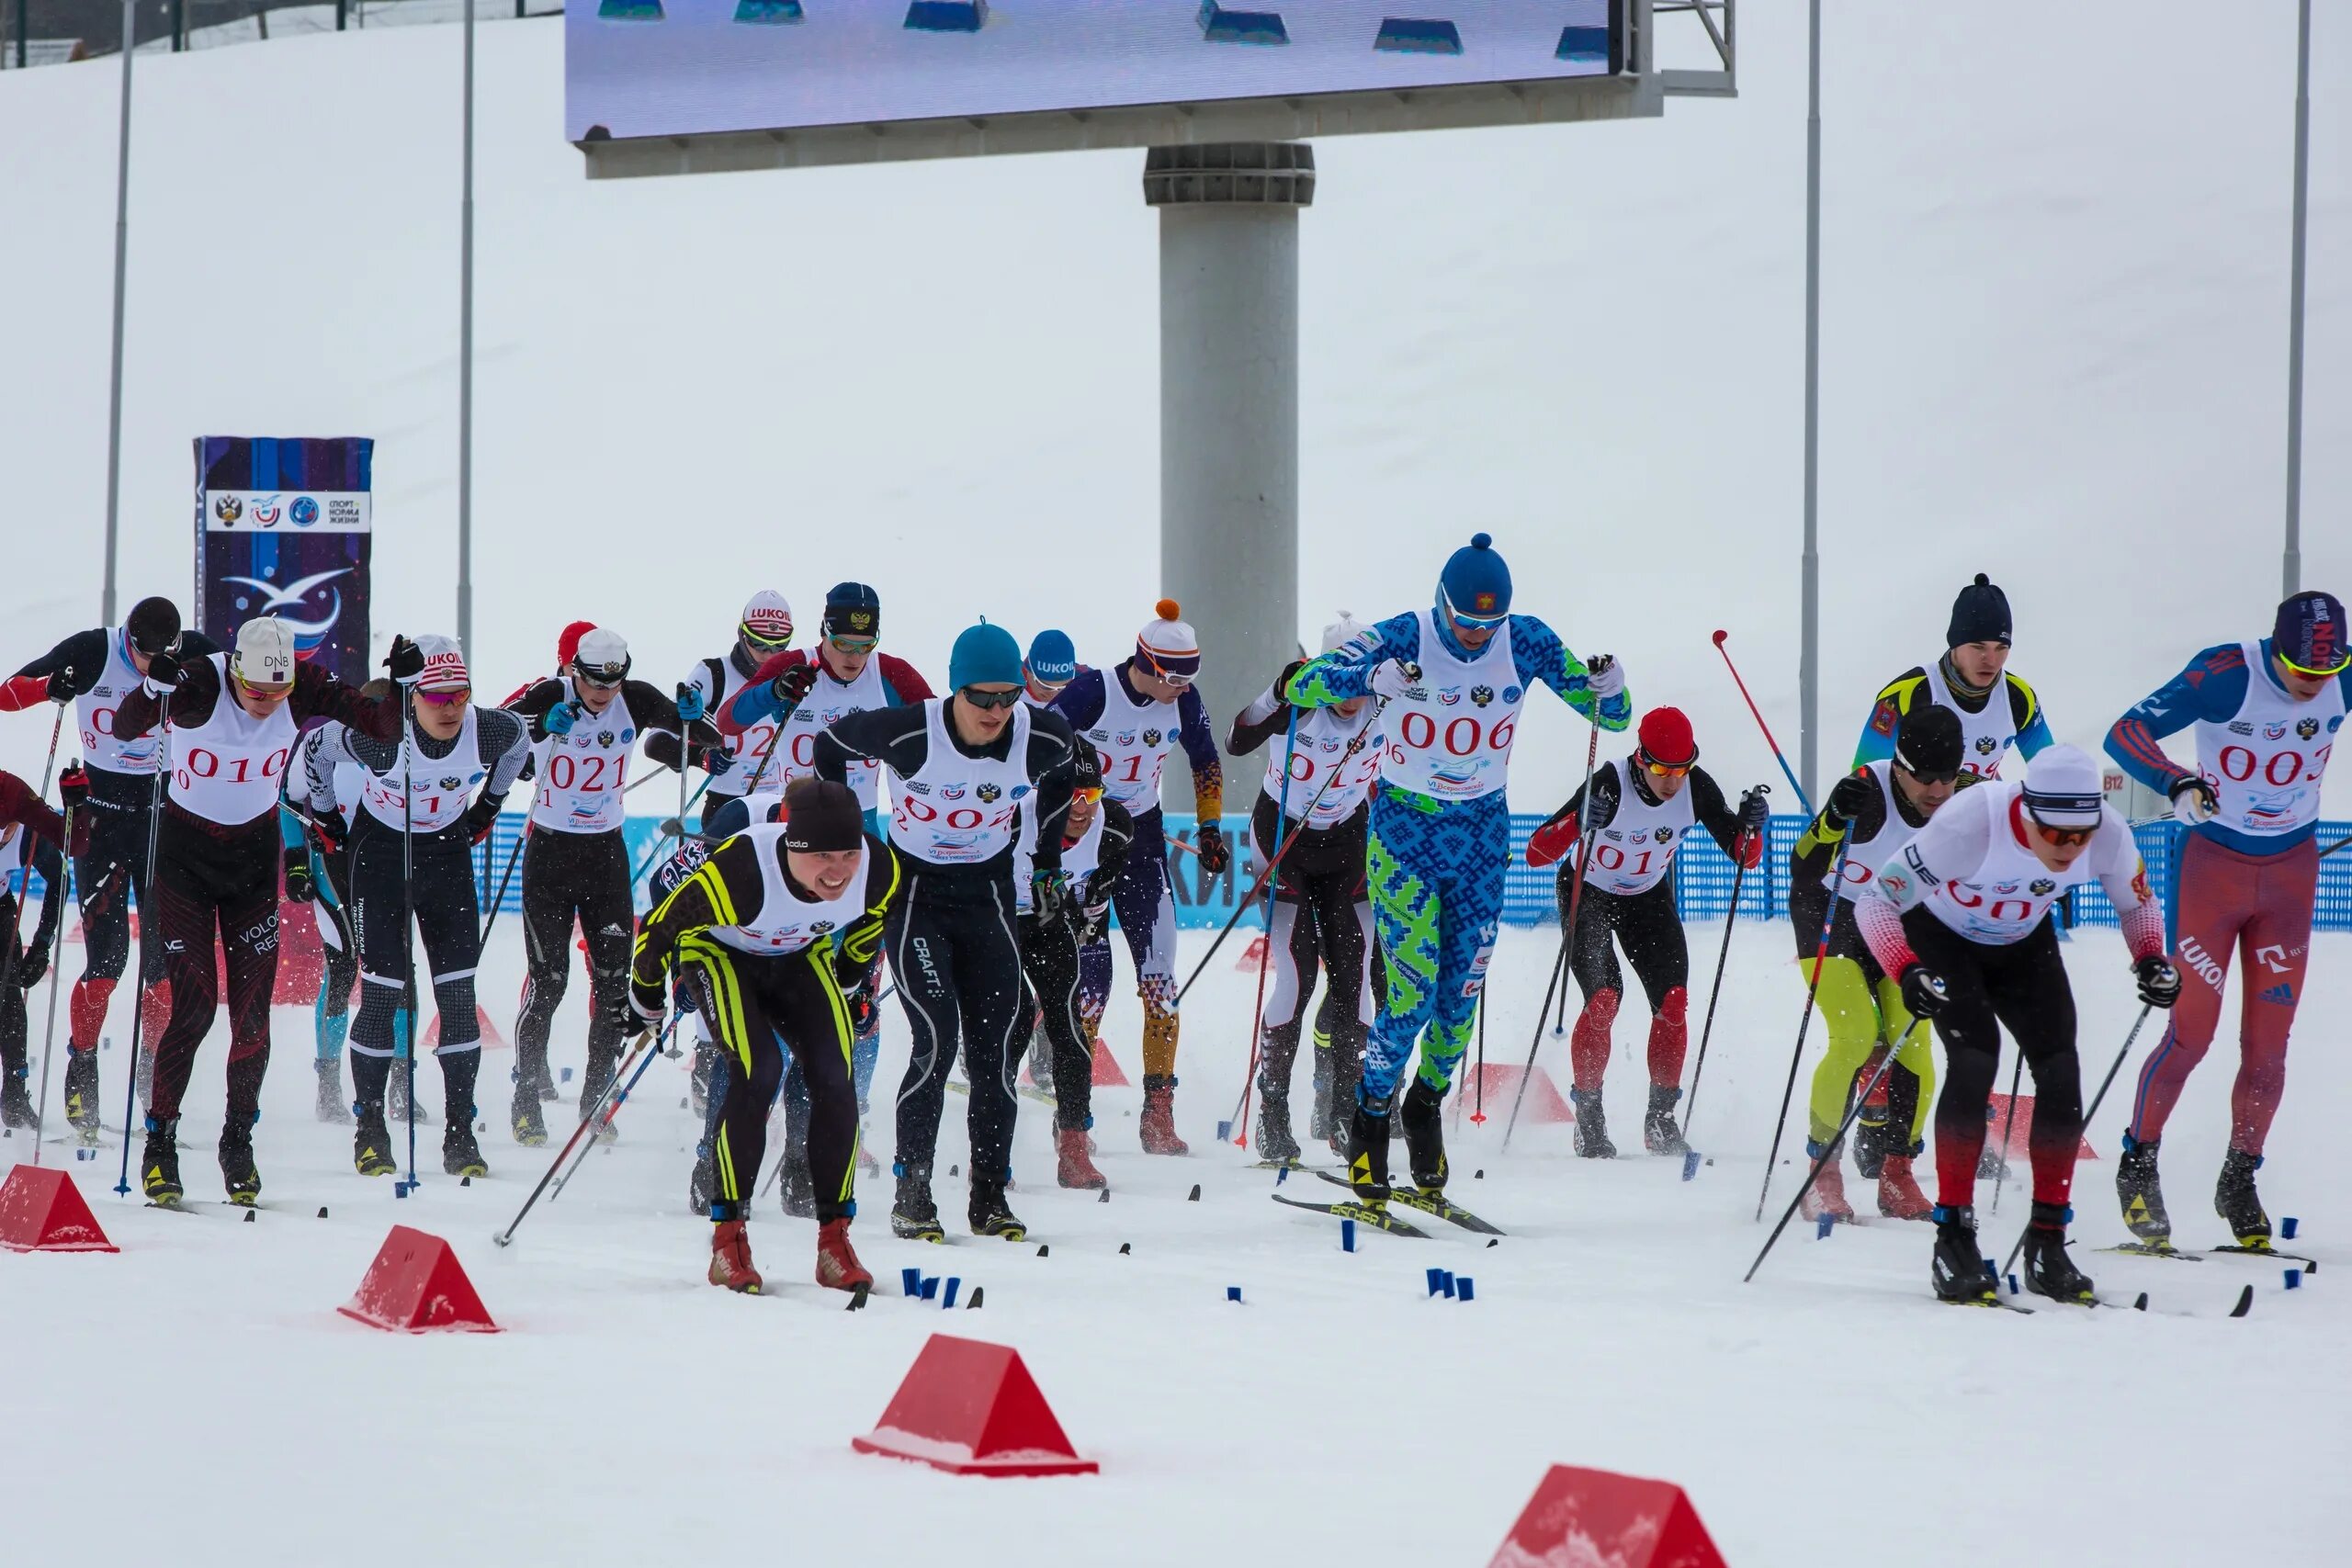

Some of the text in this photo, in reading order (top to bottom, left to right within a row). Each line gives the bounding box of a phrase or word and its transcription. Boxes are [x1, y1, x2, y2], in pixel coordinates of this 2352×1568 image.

[751, 608, 790, 621] LUKOIL
[264, 648, 289, 672] DNB
[1037, 660, 1073, 673] LUKOIL
[1401, 711, 1515, 756] 006
[550, 753, 626, 792] 021
[599, 929, 628, 937] adidas
[913, 937, 942, 987] CRAFT
[1330, 1204, 1379, 1226] FISCHER
